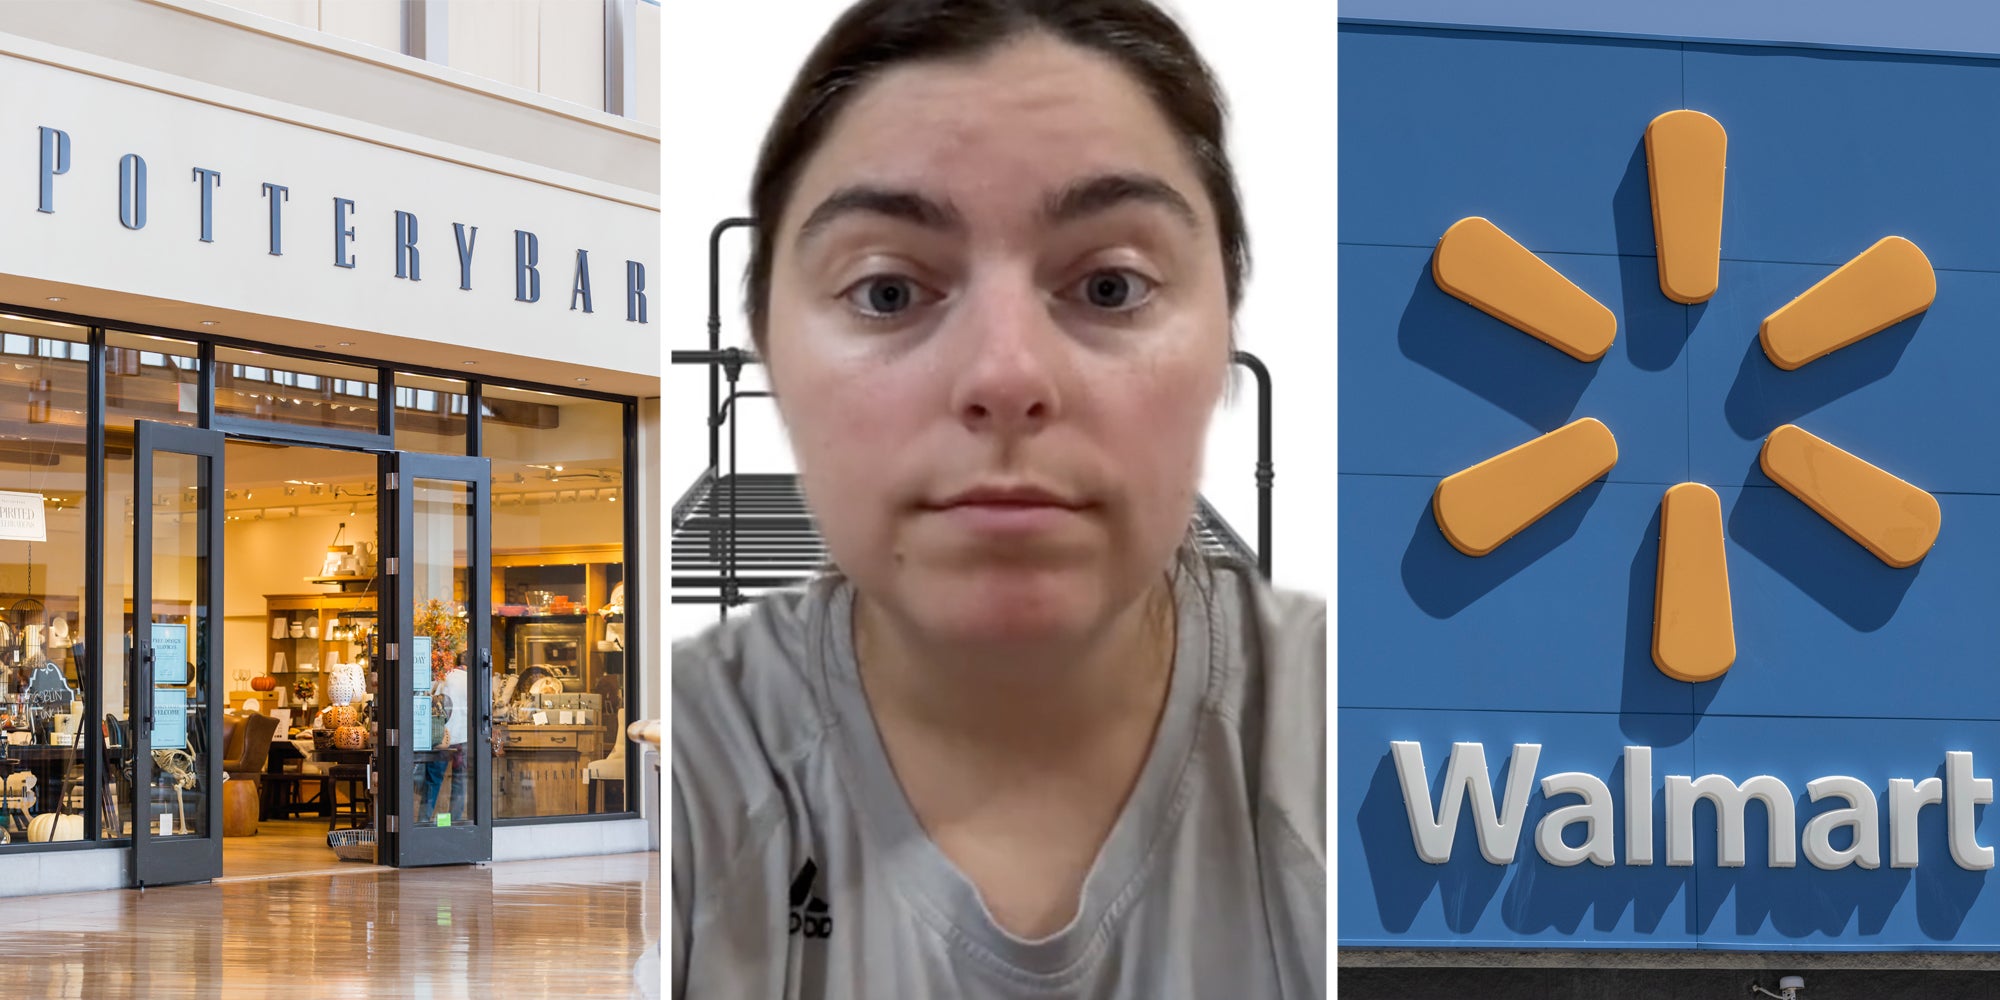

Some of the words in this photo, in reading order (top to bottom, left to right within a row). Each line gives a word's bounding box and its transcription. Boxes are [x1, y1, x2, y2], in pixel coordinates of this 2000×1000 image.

[36, 125, 478, 290] POTTERY
[513, 228, 649, 324] BAR
[1389, 740, 1995, 871] Walmart
